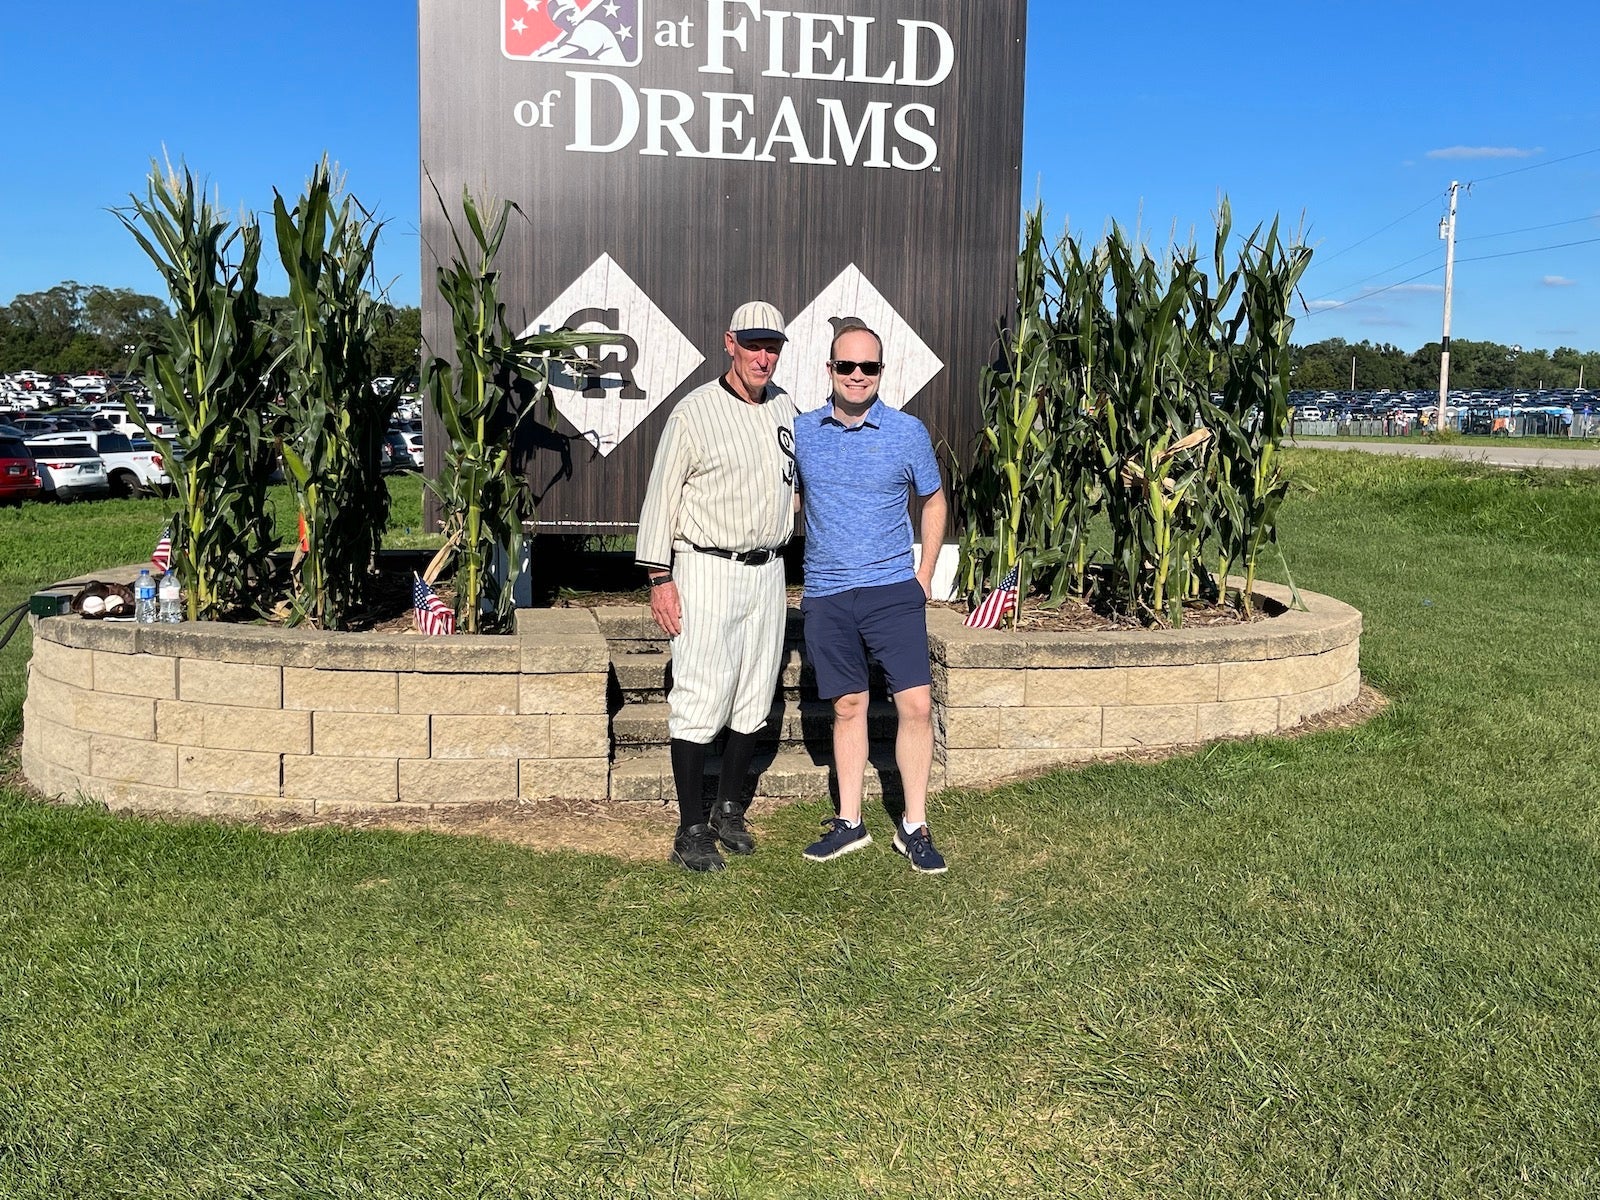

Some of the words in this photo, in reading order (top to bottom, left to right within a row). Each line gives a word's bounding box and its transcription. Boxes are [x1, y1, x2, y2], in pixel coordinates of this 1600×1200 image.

[654, 15, 695, 49] at
[698, 0, 955, 87] FIELD
[513, 90, 562, 128] of
[565, 70, 938, 171] DREAMS
